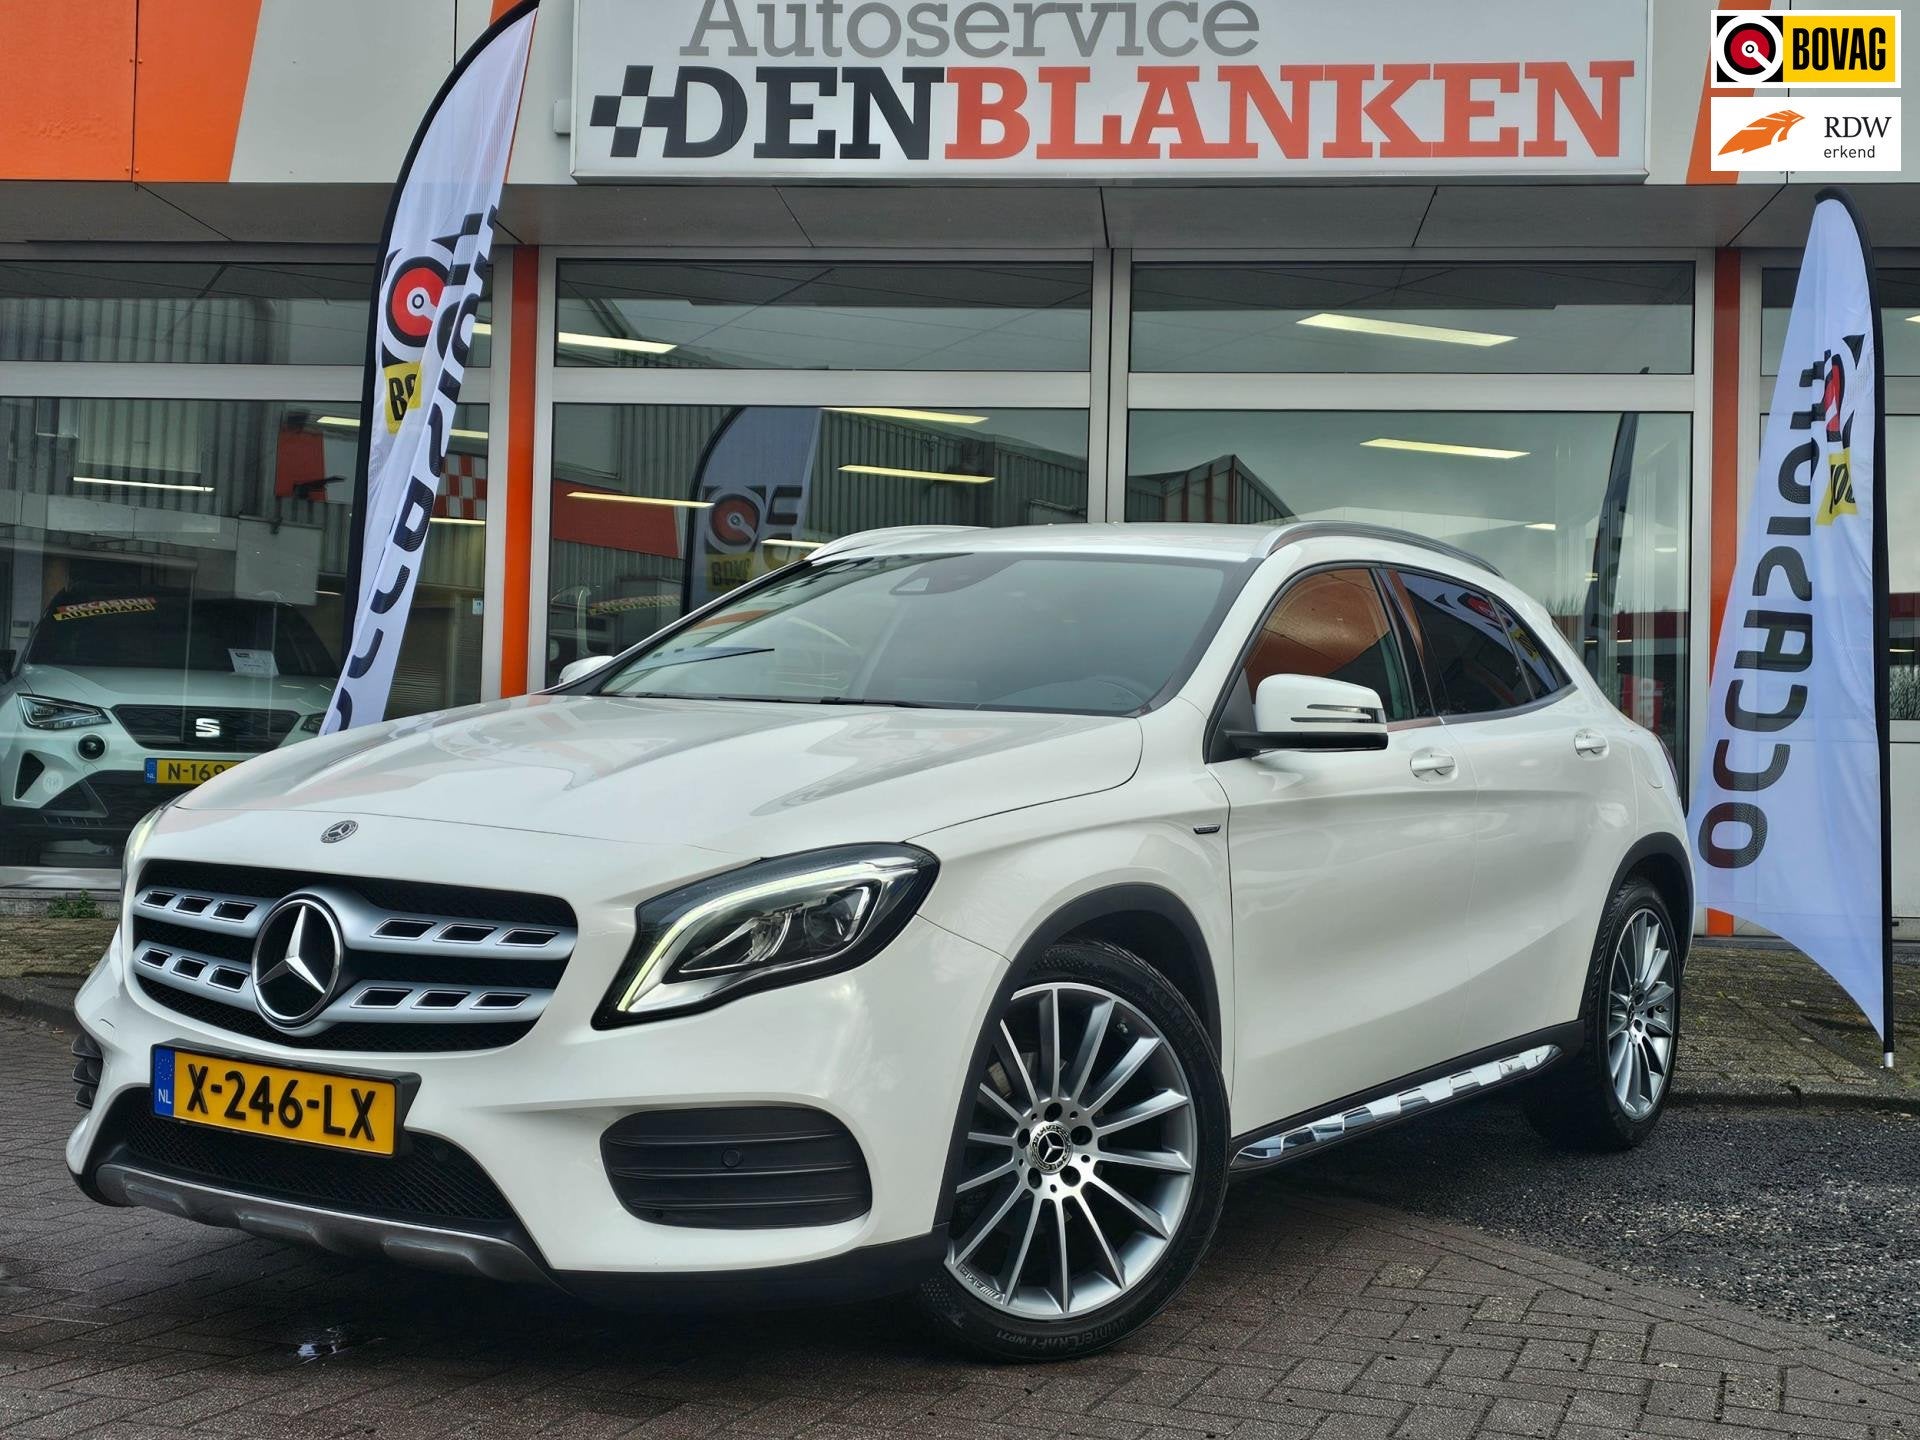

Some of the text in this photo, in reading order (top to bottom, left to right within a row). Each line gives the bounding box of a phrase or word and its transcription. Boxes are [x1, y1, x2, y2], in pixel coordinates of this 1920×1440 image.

[679, 0, 1259, 57] Autoservice
[158, 1089, 172, 1104] NL
[187, 1064, 376, 1141] X-246-LX
